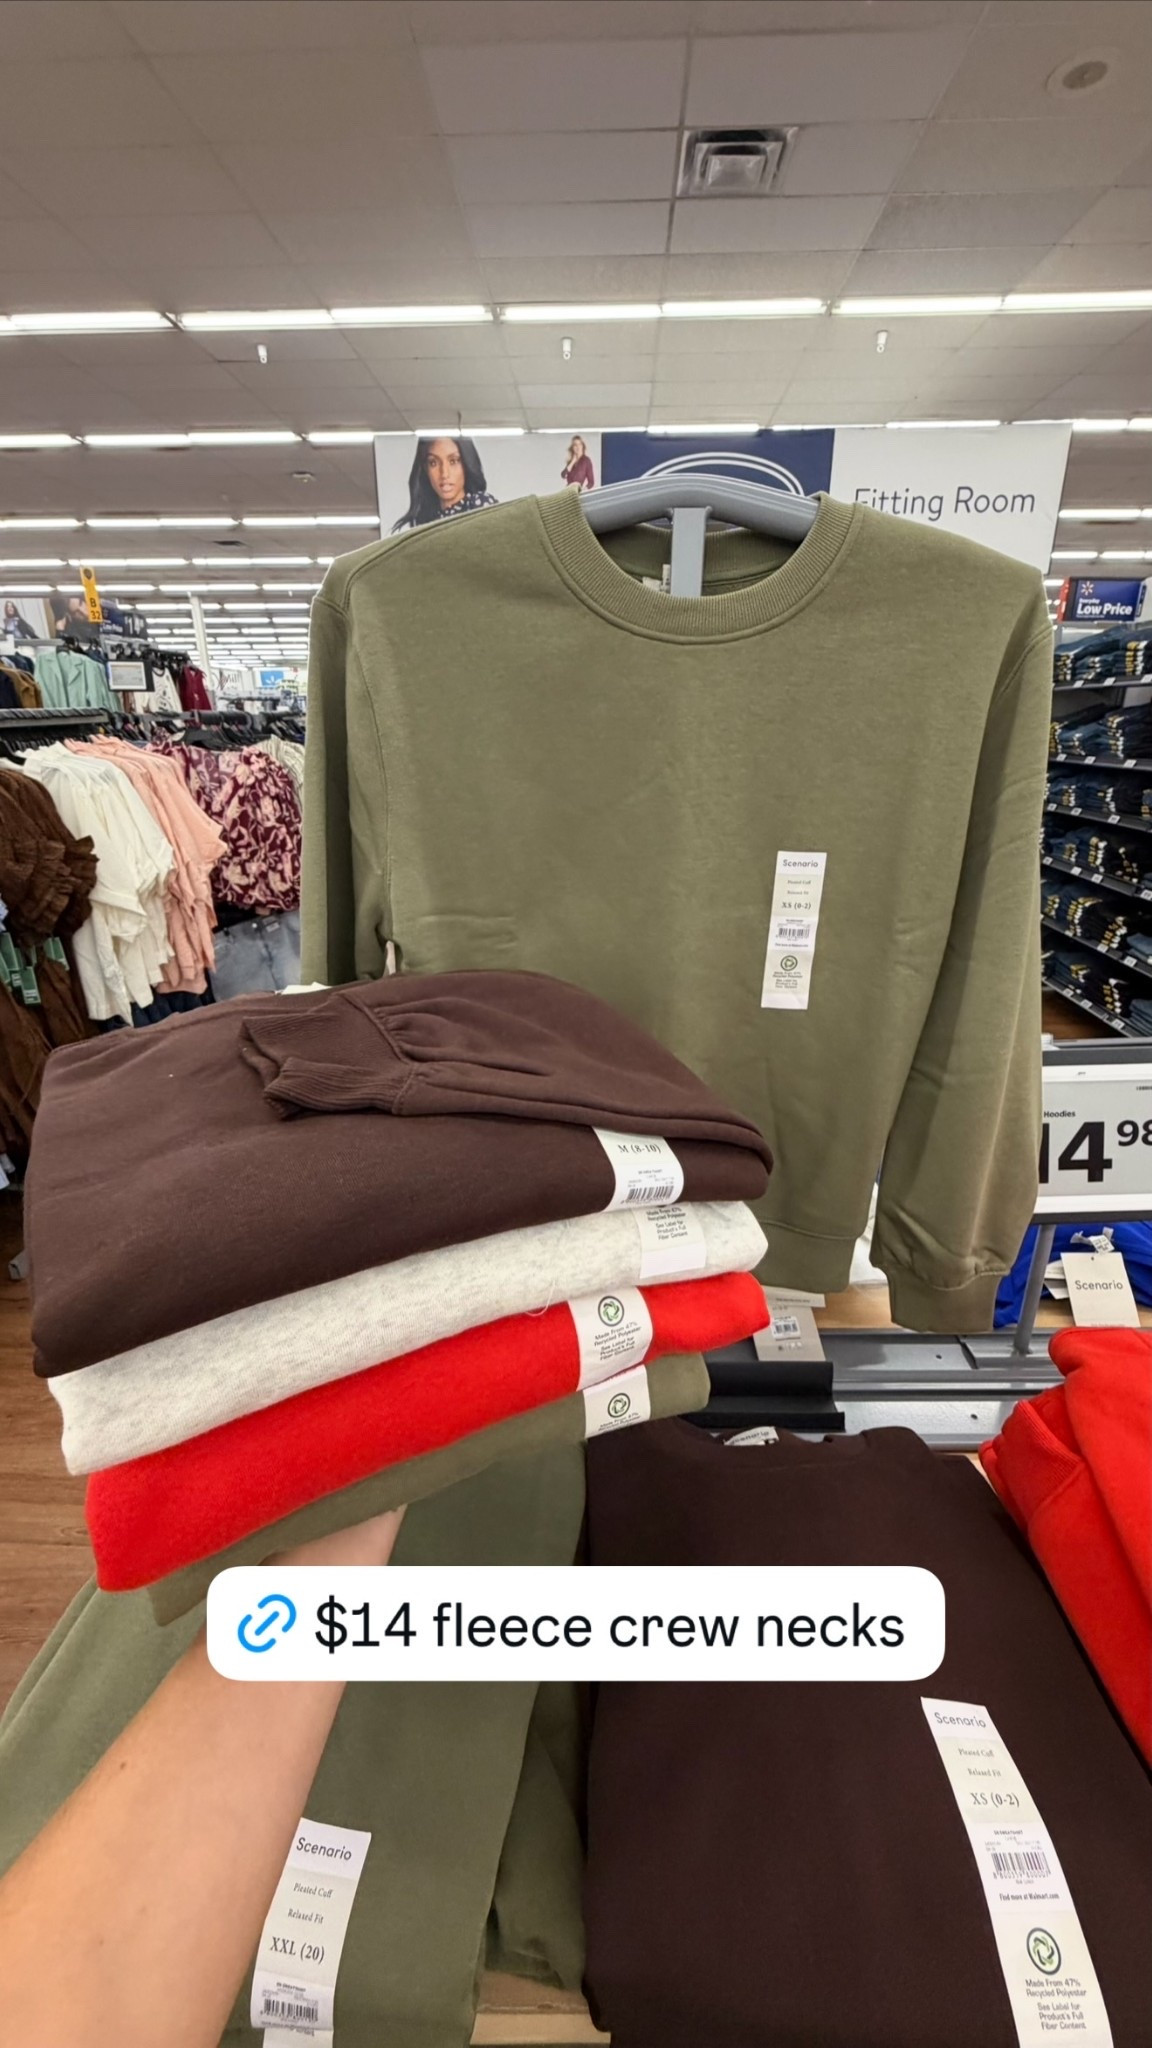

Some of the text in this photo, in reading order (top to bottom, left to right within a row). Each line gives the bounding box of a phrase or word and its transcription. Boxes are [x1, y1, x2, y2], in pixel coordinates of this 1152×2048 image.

[855, 486, 1035, 521] Fitting Room
[89, 597, 97, 608] B
[1076, 602, 1133, 615] Low Price
[90, 610, 102, 620] 32
[782, 859, 819, 868] Scenario
[794, 902, 811, 910] (0-2)
[1043, 1110, 1076, 1118] Hoodies
[618, 1144, 662, 1154] M (8-10)
[1075, 1280, 1124, 1290] Scenario
[934, 1711, 987, 1728] Scenario
[970, 1792, 1020, 1808] XS (0-2)
[296, 1837, 352, 1861] Scenario
[294, 1883, 334, 1899] Pleated Cuff
[288, 1909, 324, 1925] Relaxed Fit
[270, 1936, 325, 1965] XXL (20)
[1026, 1978, 1081, 1987] Made From 47%
[1026, 1989, 1087, 1998] Recycled Polyester
[1038, 2002, 1080, 2010] See Label for
[1040, 2012, 1084, 2020] Product's Full
[1041, 2022, 1058, 2030] Fiber
